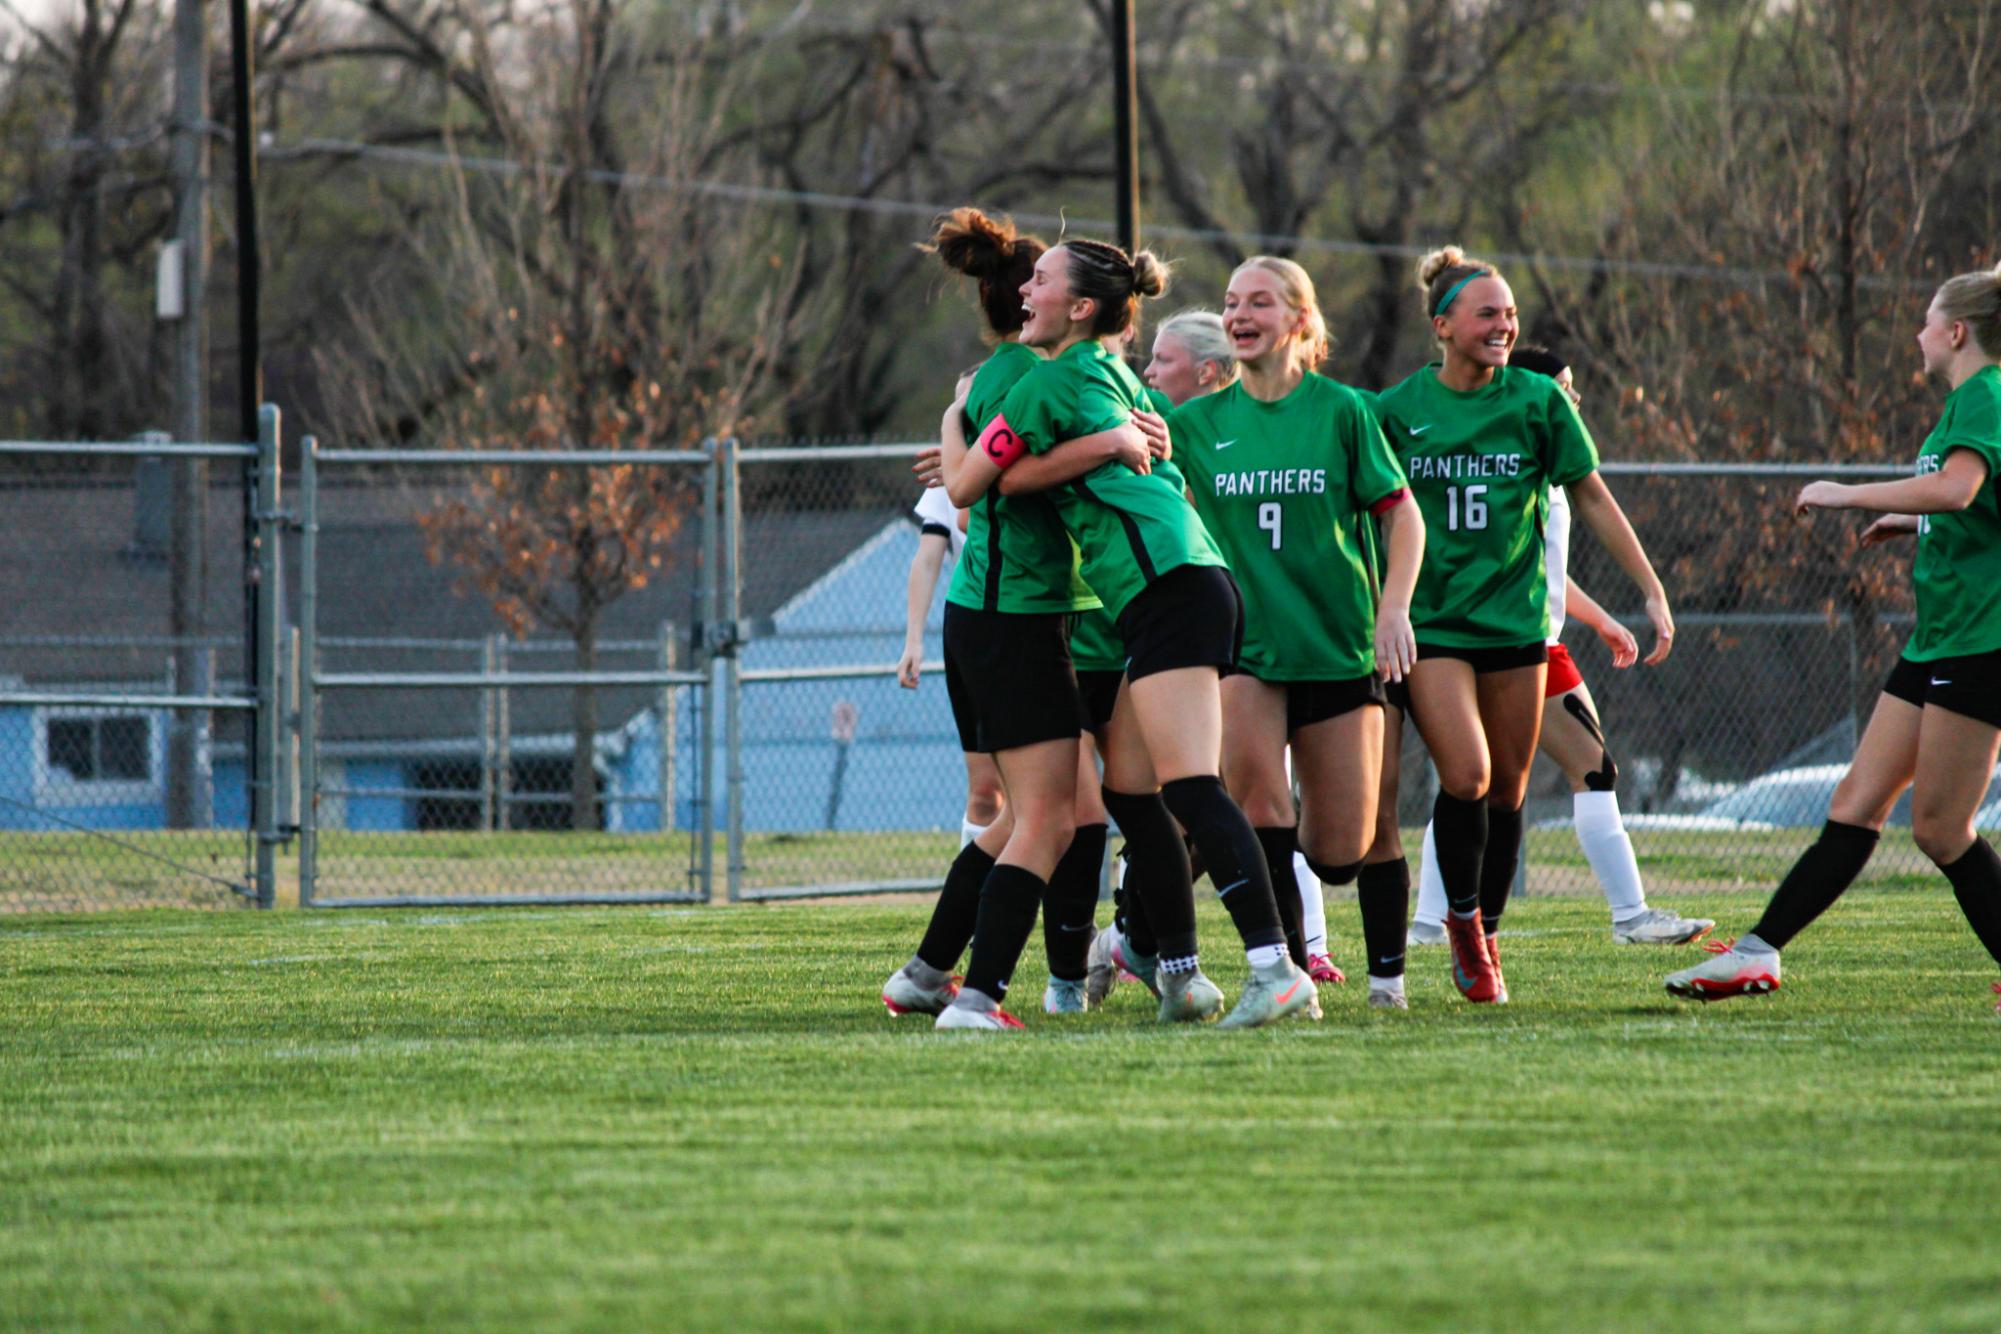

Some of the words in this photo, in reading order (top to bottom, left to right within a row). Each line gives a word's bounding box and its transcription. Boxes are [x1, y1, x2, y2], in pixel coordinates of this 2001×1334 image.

[988, 429, 1013, 458] C
[1410, 453, 1521, 479] PANTHERS
[1215, 468, 1326, 497] PANTHERS
[1446, 484, 1488, 531] 16
[1258, 502, 1282, 550] 9
